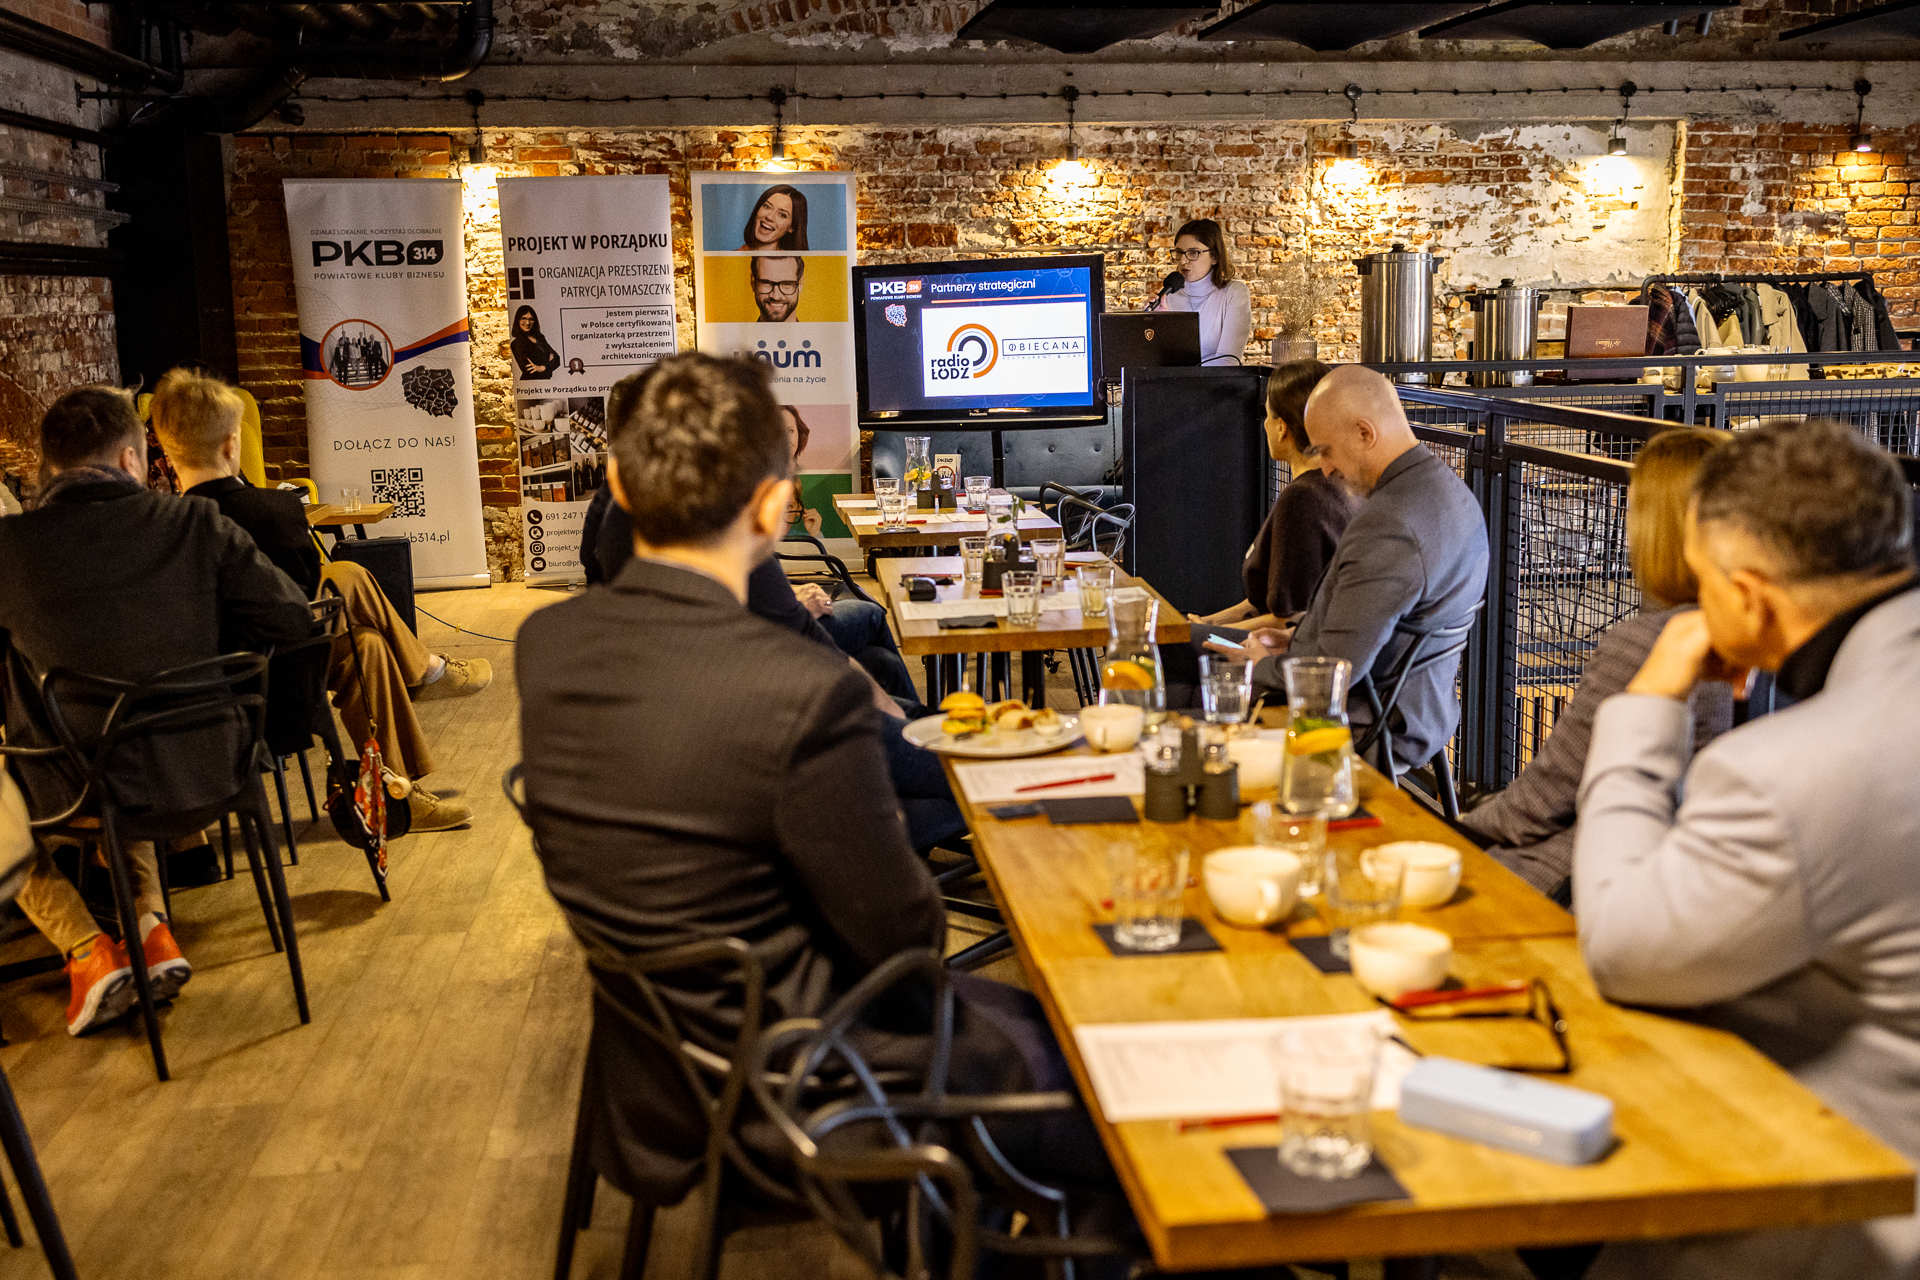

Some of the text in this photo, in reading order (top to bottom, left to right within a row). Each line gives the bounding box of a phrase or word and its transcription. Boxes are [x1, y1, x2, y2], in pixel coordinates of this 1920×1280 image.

[508, 233, 668, 254] PROJEKT W PORZĄDKU
[312, 240, 437, 267] PKB 314
[538, 264, 670, 280] ORGANIZACJA PRZESTRZENI
[560, 284, 671, 299] PATRYCJA TOMASZCZYK
[870, 281, 906, 295] PKB
[931, 279, 1036, 294] Partnerzy strategiczni
[606, 309, 668, 318] Jestem pierwszą
[616, 320, 671, 329] certyfikowaną
[571, 330, 670, 341] organizatorką przestrzeni
[611, 341, 672, 350] wykształceniem
[931, 354, 970, 367] radio
[806, 376, 826, 384] życie
[334, 436, 456, 452] DOŁĄCZ DO NAS!
